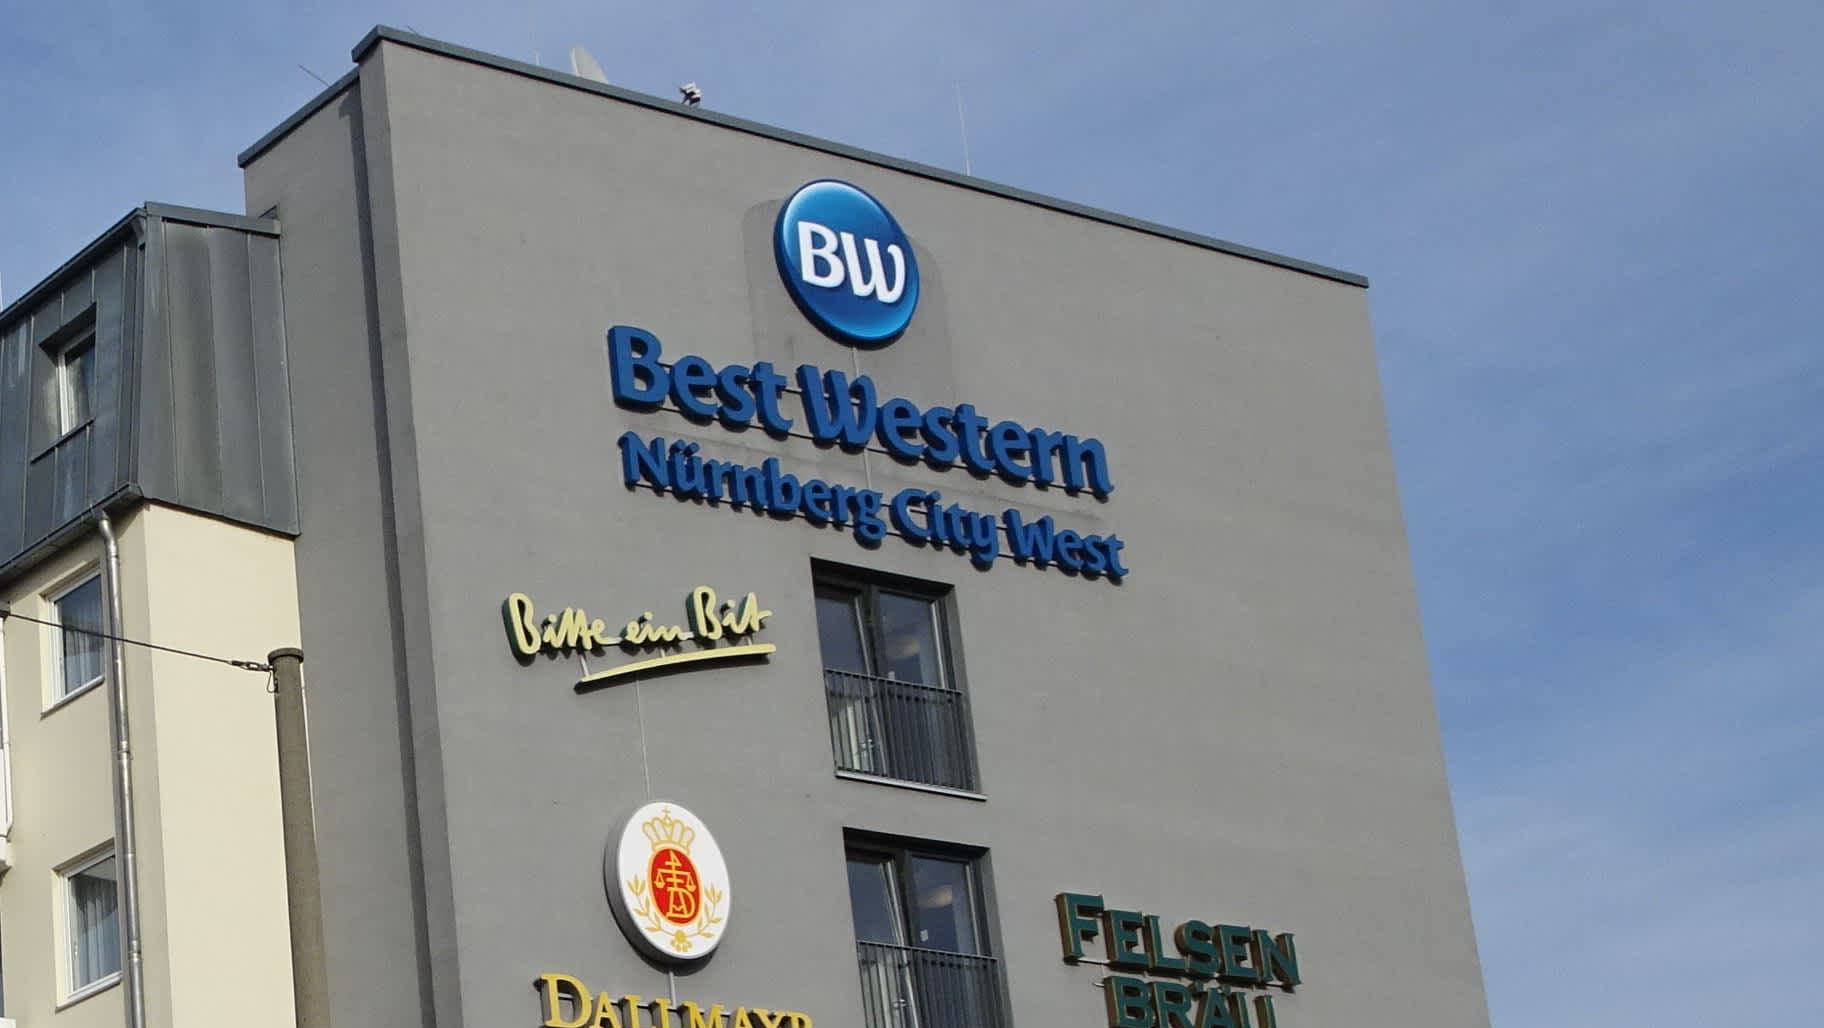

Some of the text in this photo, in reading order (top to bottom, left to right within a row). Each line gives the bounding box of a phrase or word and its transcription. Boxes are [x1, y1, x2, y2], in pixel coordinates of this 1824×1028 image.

[797, 220, 906, 304] BW
[608, 325, 1114, 496] Best Western
[619, 431, 1129, 577] Nürnberg City West
[503, 585, 772, 658] Bitte ein Bit
[1056, 891, 1302, 985] FELSEN
